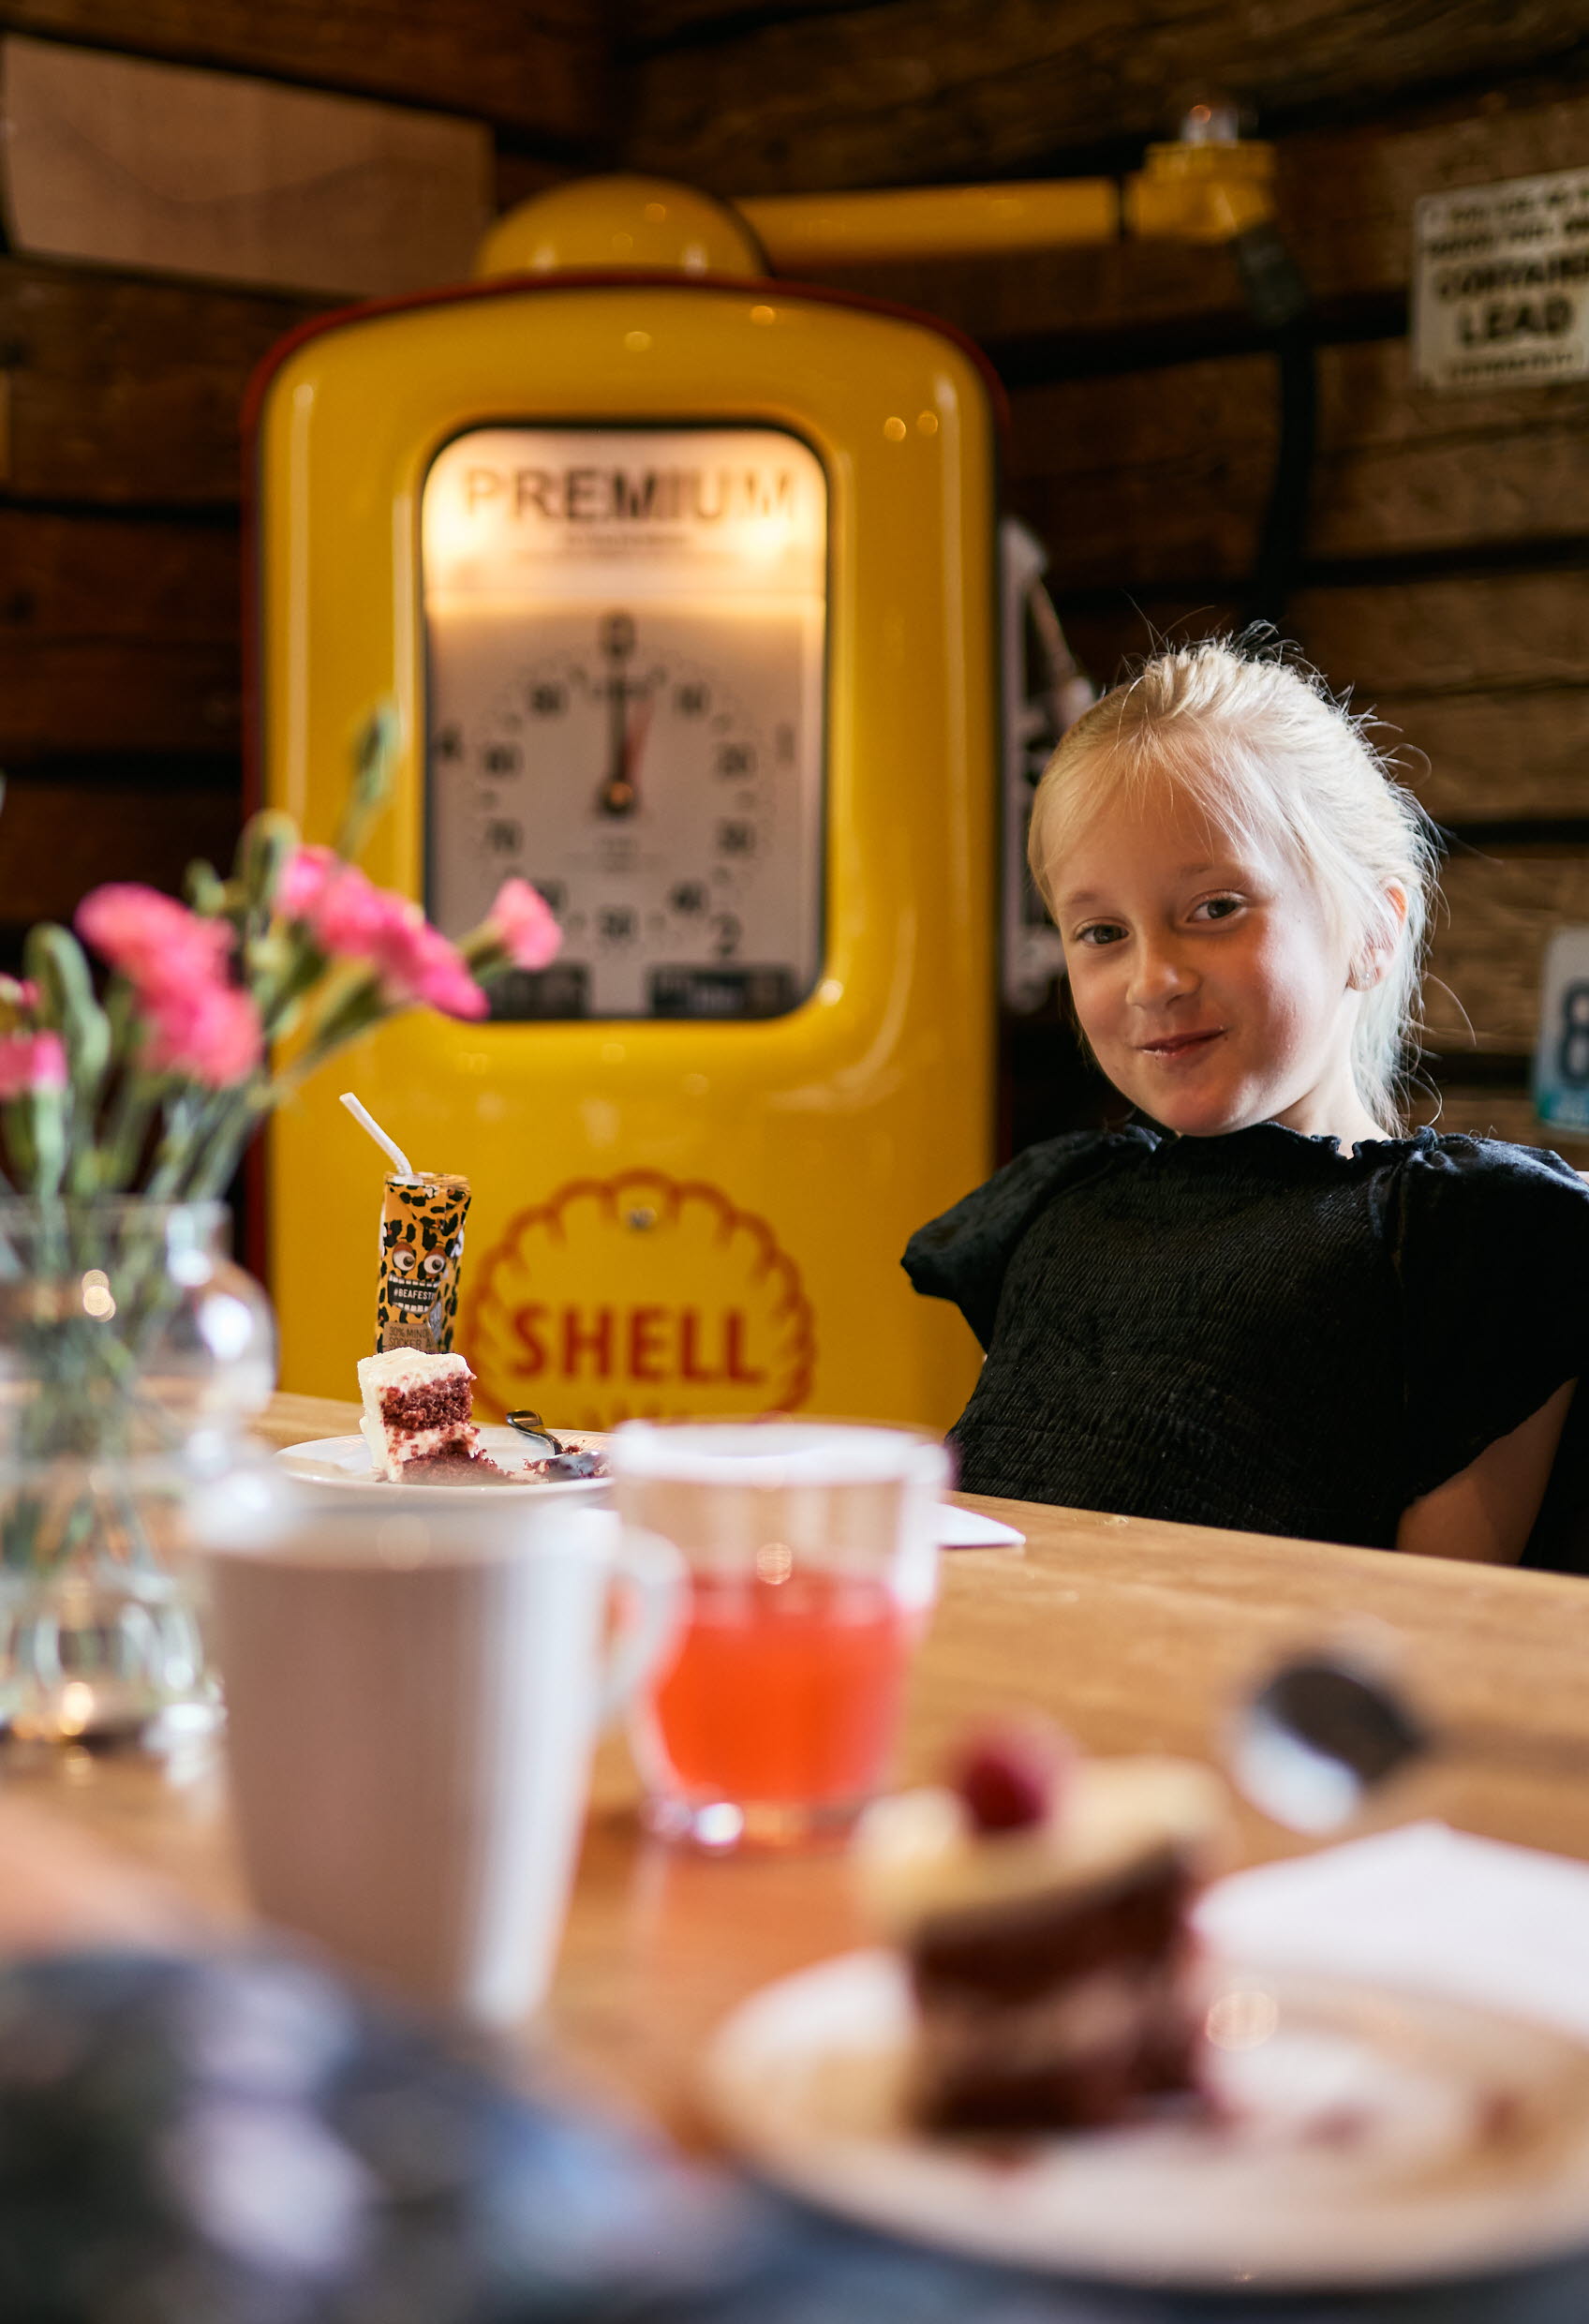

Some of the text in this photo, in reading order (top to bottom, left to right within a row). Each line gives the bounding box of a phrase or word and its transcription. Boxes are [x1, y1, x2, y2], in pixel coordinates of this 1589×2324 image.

[1434, 251, 1589, 301] CONTAIN
[1457, 294, 1575, 347] LEAD
[466, 467, 794, 521] PREMIUM
[510, 1301, 766, 1383] SHELL
